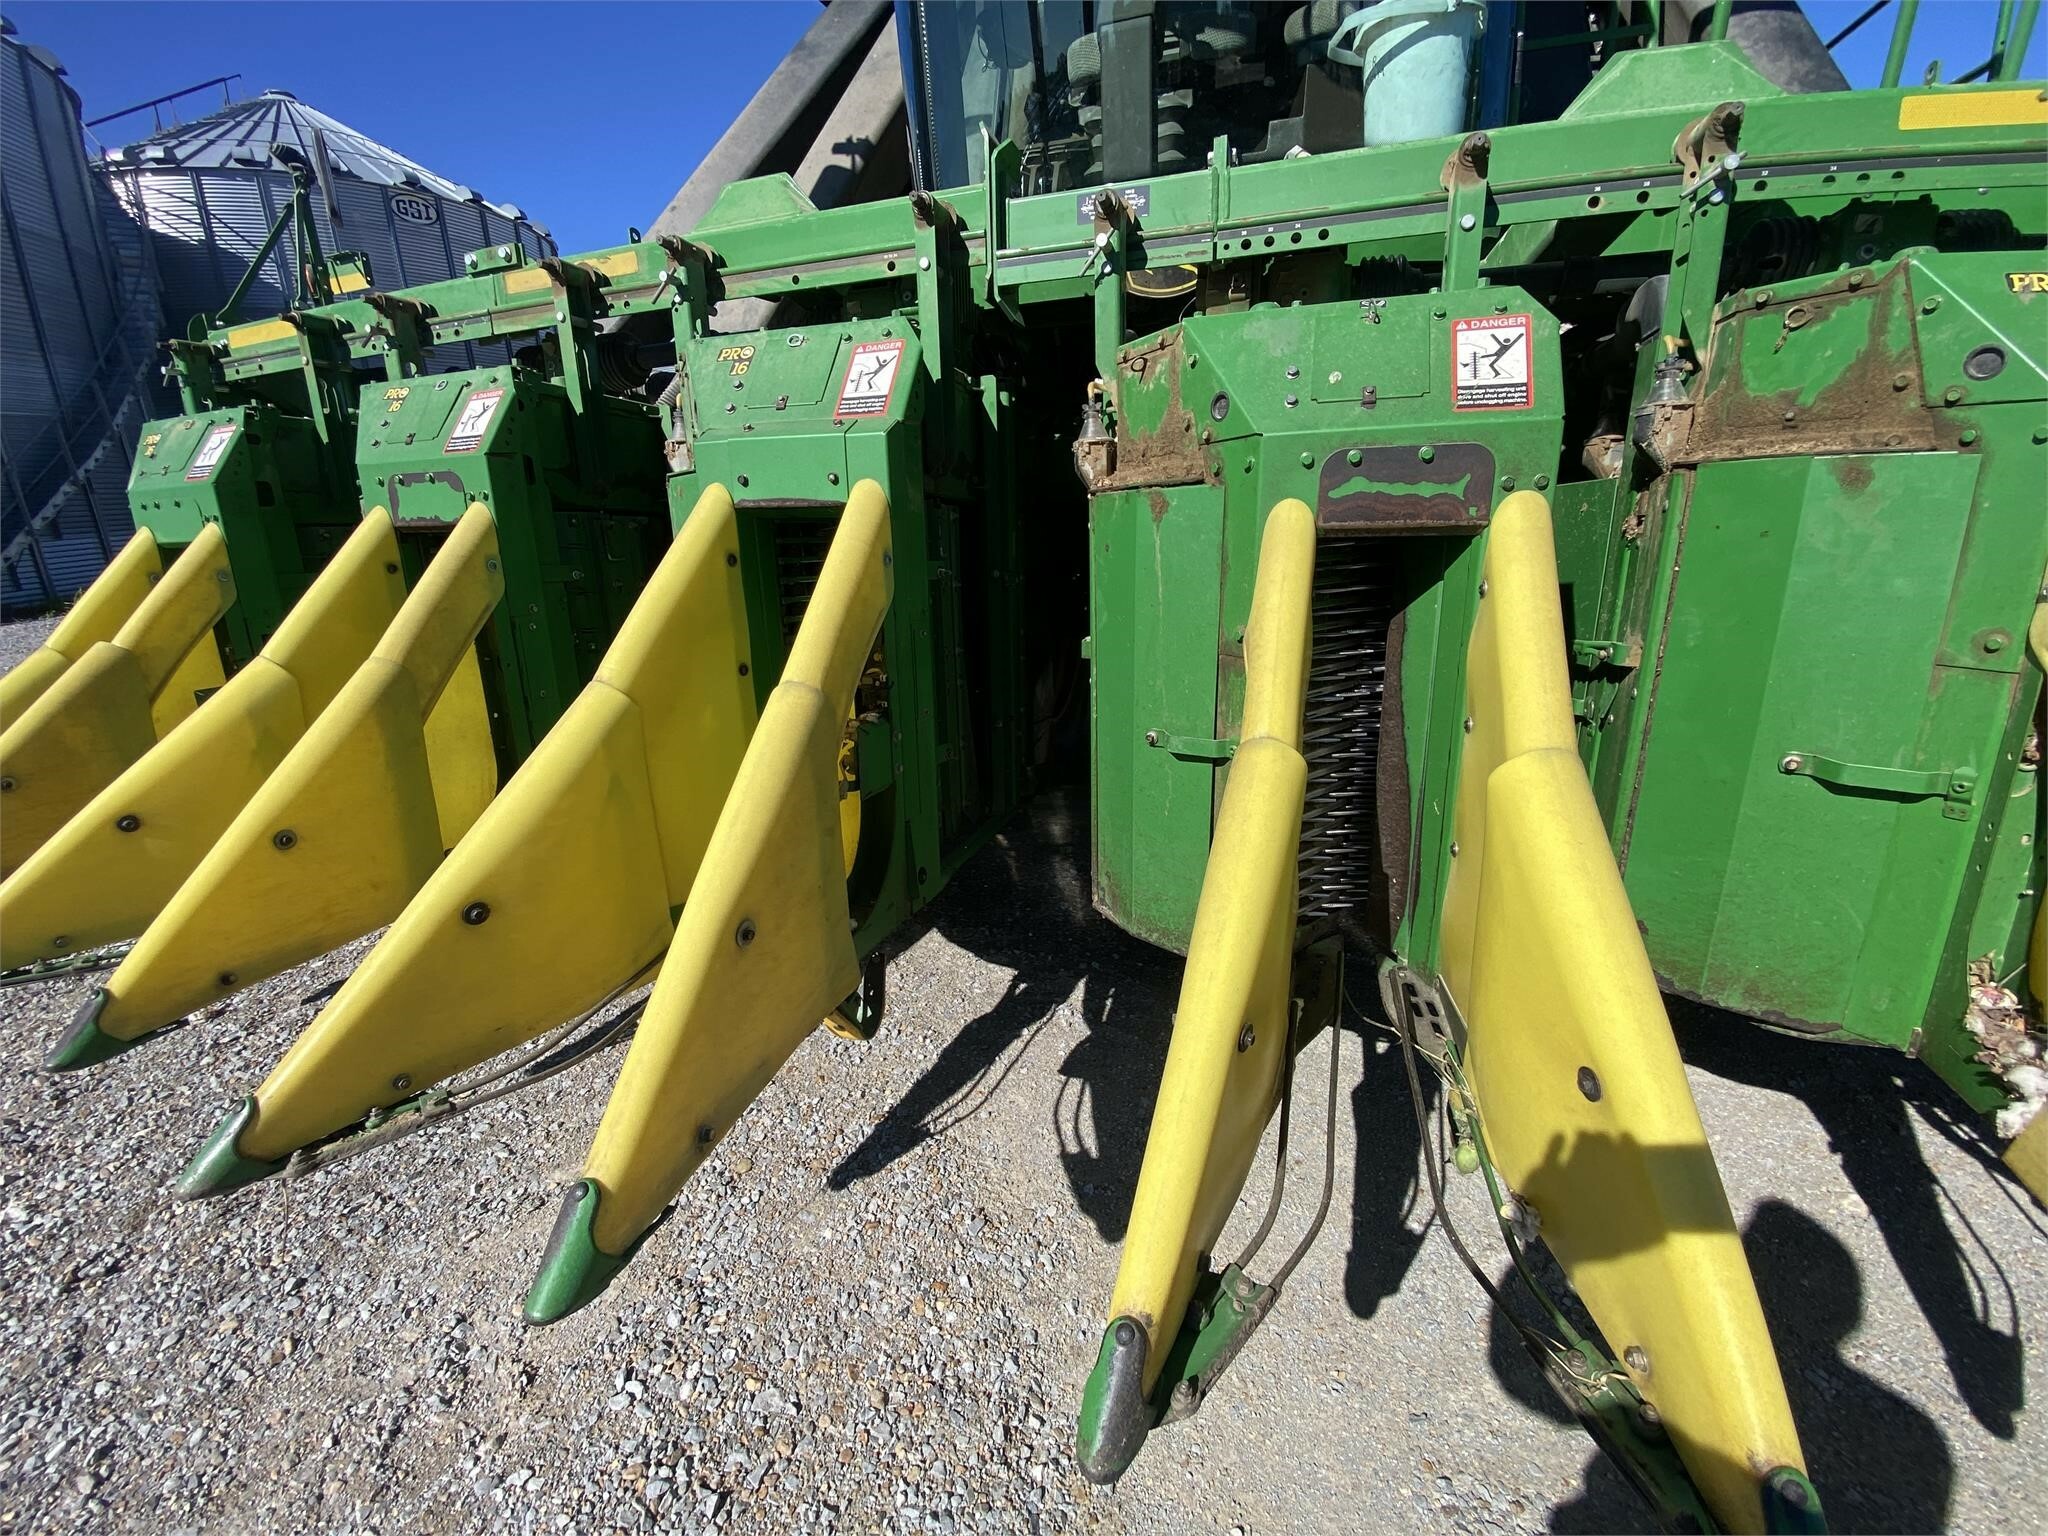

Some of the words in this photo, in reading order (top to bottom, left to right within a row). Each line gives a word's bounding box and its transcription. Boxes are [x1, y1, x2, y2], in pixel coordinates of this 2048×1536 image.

[395, 199, 433, 221] GSI
[1470, 316, 1526, 329] DANGER
[865, 341, 902, 351] DANGER
[717, 346, 755, 362] PRO
[730, 361, 750, 376] 16
[383, 387, 410, 400] PRO
[388, 400, 403, 412] 16
